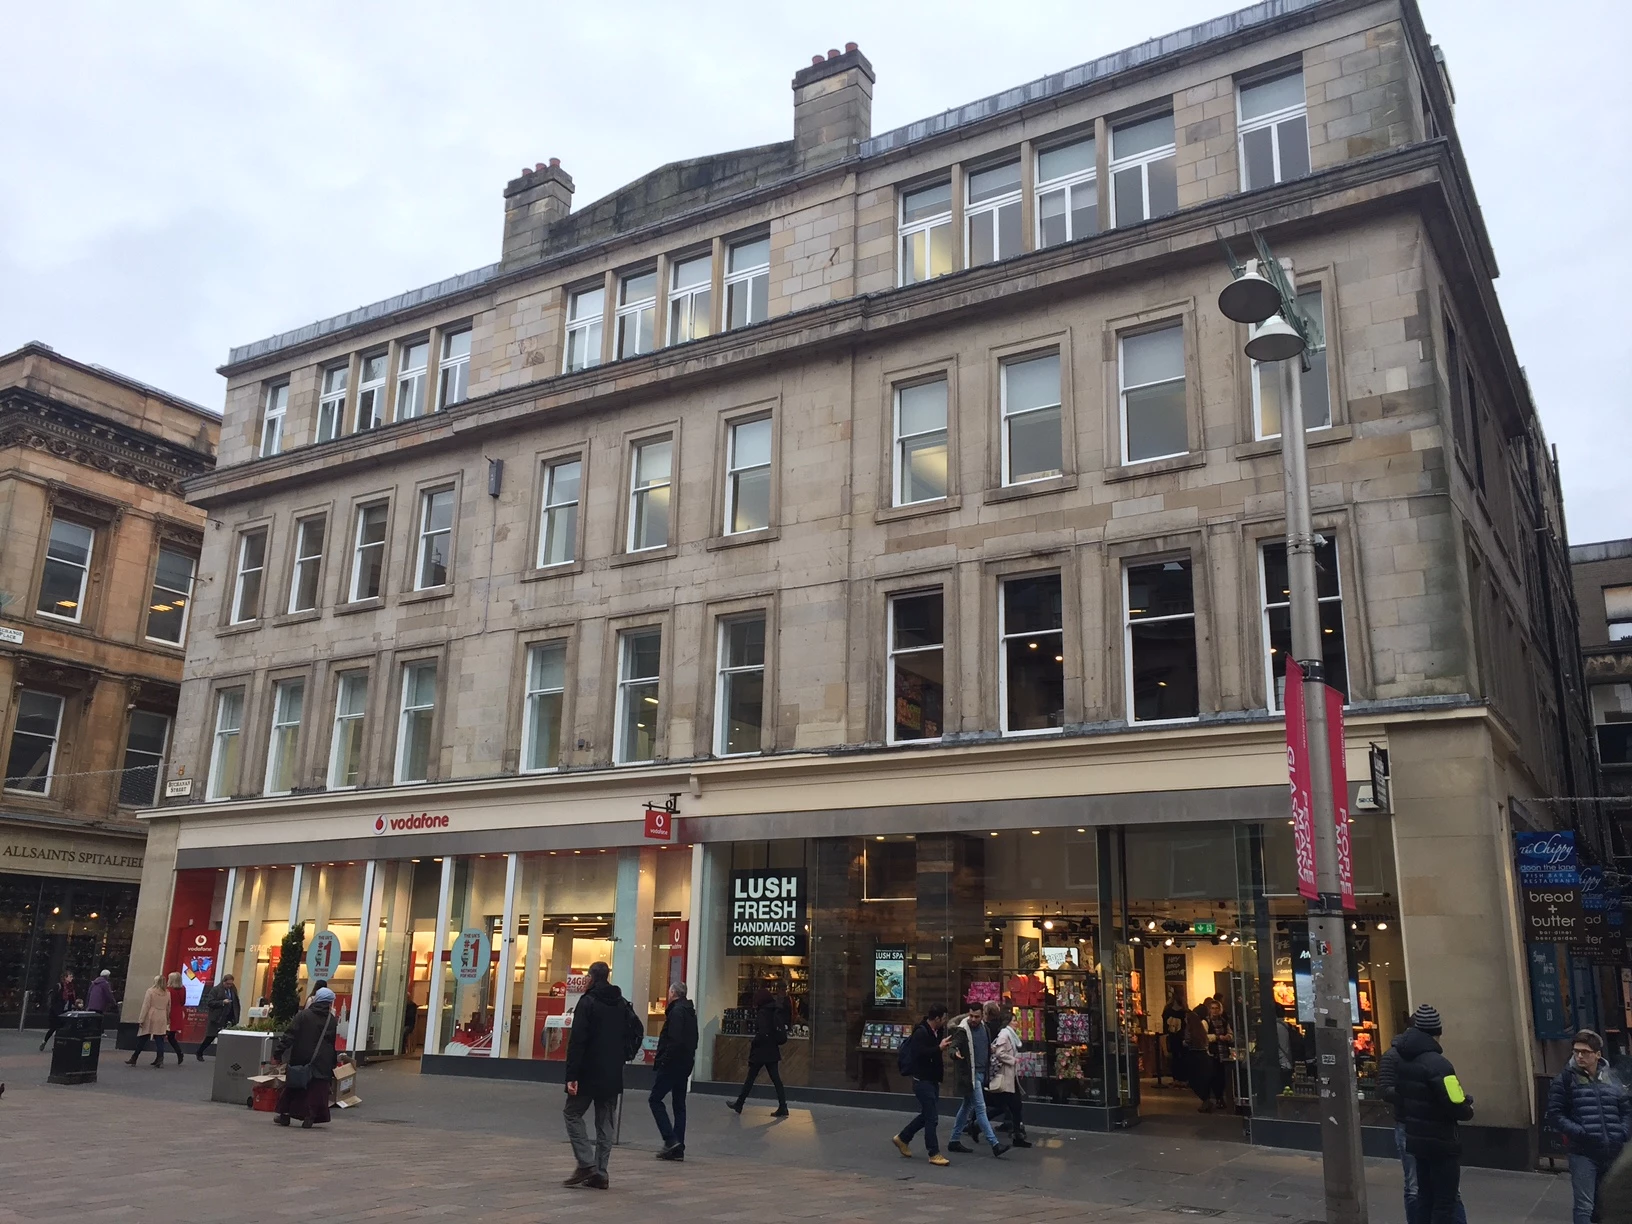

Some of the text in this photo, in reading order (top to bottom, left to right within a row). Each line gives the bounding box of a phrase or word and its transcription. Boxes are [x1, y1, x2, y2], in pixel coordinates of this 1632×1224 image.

[390, 812, 449, 830] vodafone
[1298, 808, 1310, 883] MAKE
[1302, 790, 1315, 885] PEOPLE
[2, 845, 76, 862] ALLSAINTS
[1339, 807, 1353, 895] PEOPLE
[1533, 833, 1574, 864] Chippy
[1335, 824, 1348, 894] MAKE
[1543, 863, 1556, 871] the
[735, 877, 797, 898] LUSH
[1529, 891, 1574, 902] bread
[734, 900, 797, 919] FRESH
[733, 922, 796, 932] HANDMADE
[1531, 915, 1576, 927] butter
[733, 935, 796, 946] COSMETICS
[875, 952, 891, 960] LUSH
